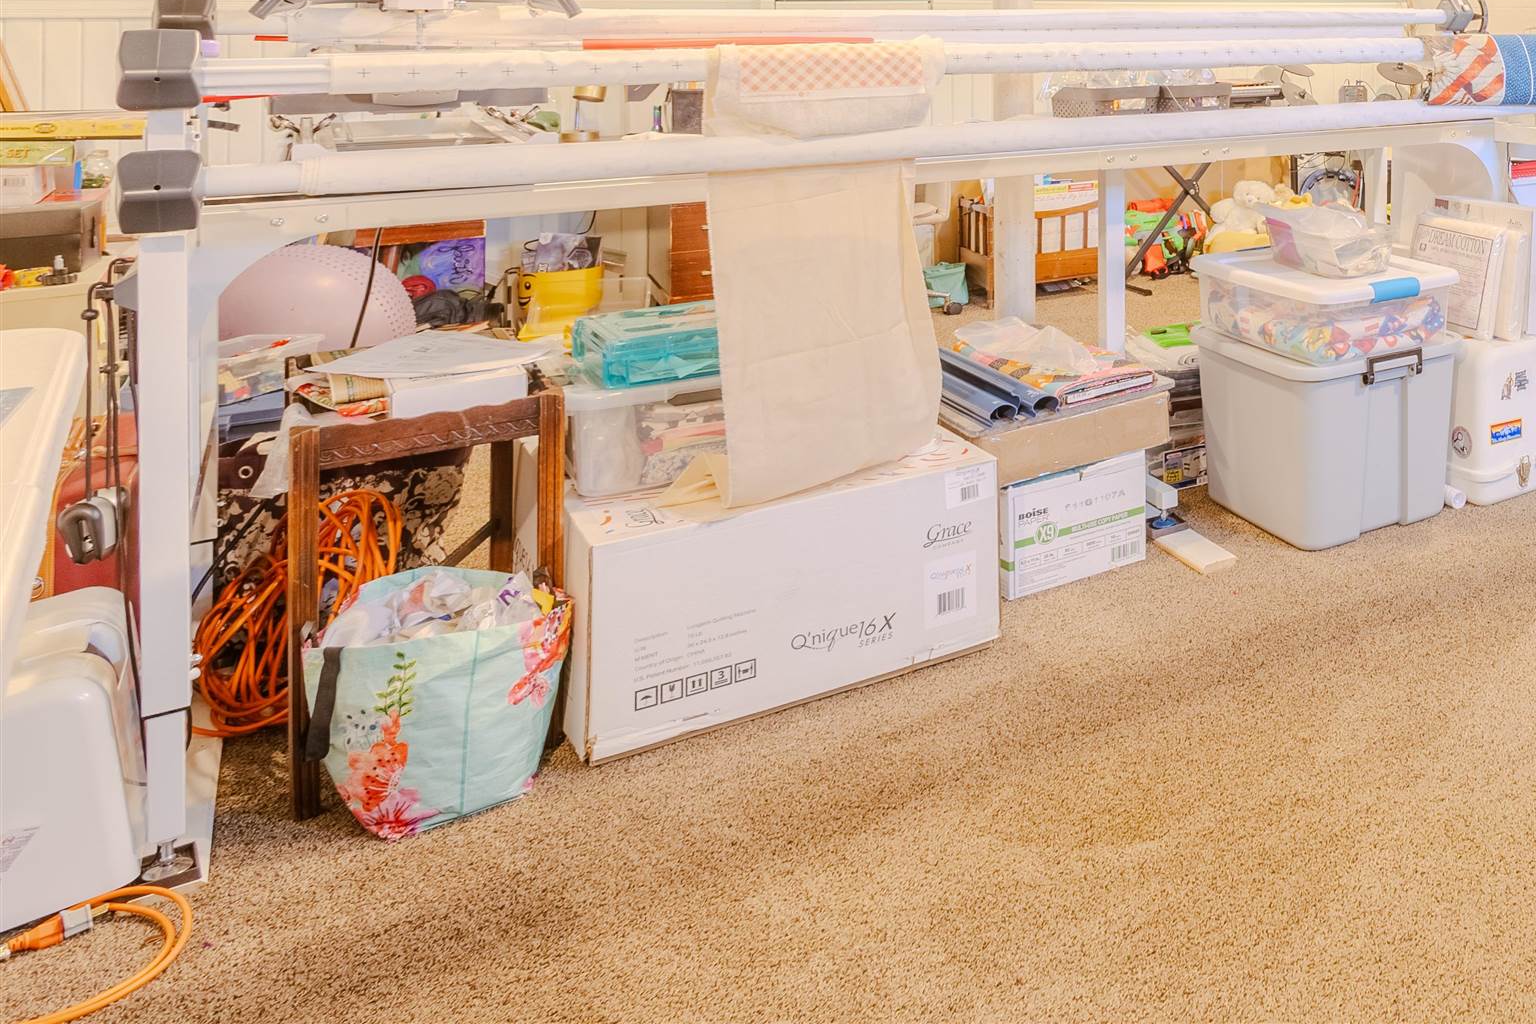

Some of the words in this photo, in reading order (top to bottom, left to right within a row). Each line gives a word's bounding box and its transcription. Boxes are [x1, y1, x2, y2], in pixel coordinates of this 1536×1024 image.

[922, 520, 973, 549] Grace
[1039, 524, 1054, 542] X9
[857, 632, 894, 649] SERIES
[719, 670, 725, 680] 3
